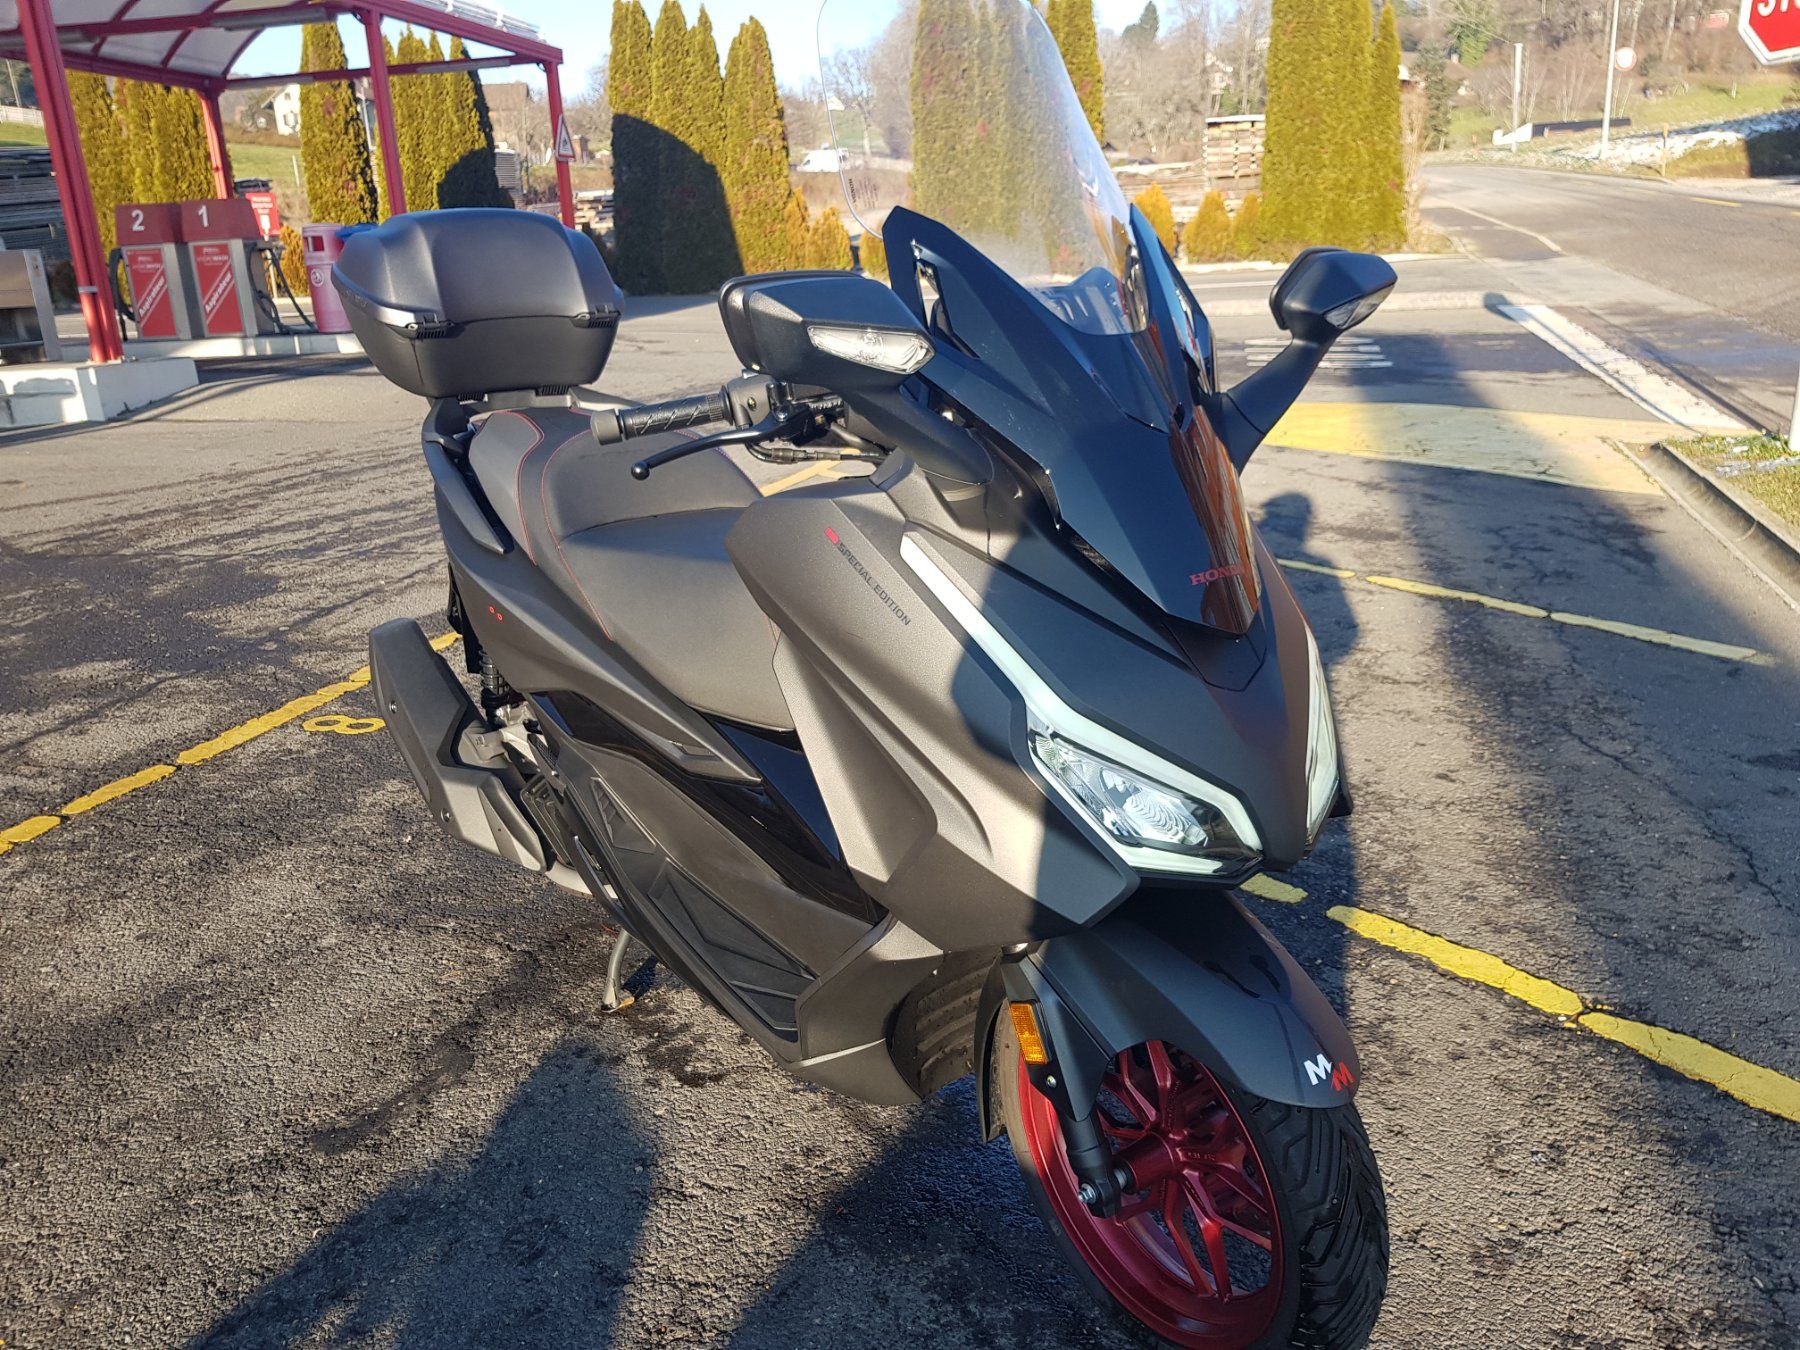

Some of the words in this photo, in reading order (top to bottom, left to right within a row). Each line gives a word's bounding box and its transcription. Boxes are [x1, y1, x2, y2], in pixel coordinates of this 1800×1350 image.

[131, 209, 145, 231] 2
[198, 205, 209, 228] 1
[205, 270, 232, 313] Aspirateur
[837, 542, 873, 586] SPECIAL
[873, 584, 911, 626] EDITION
